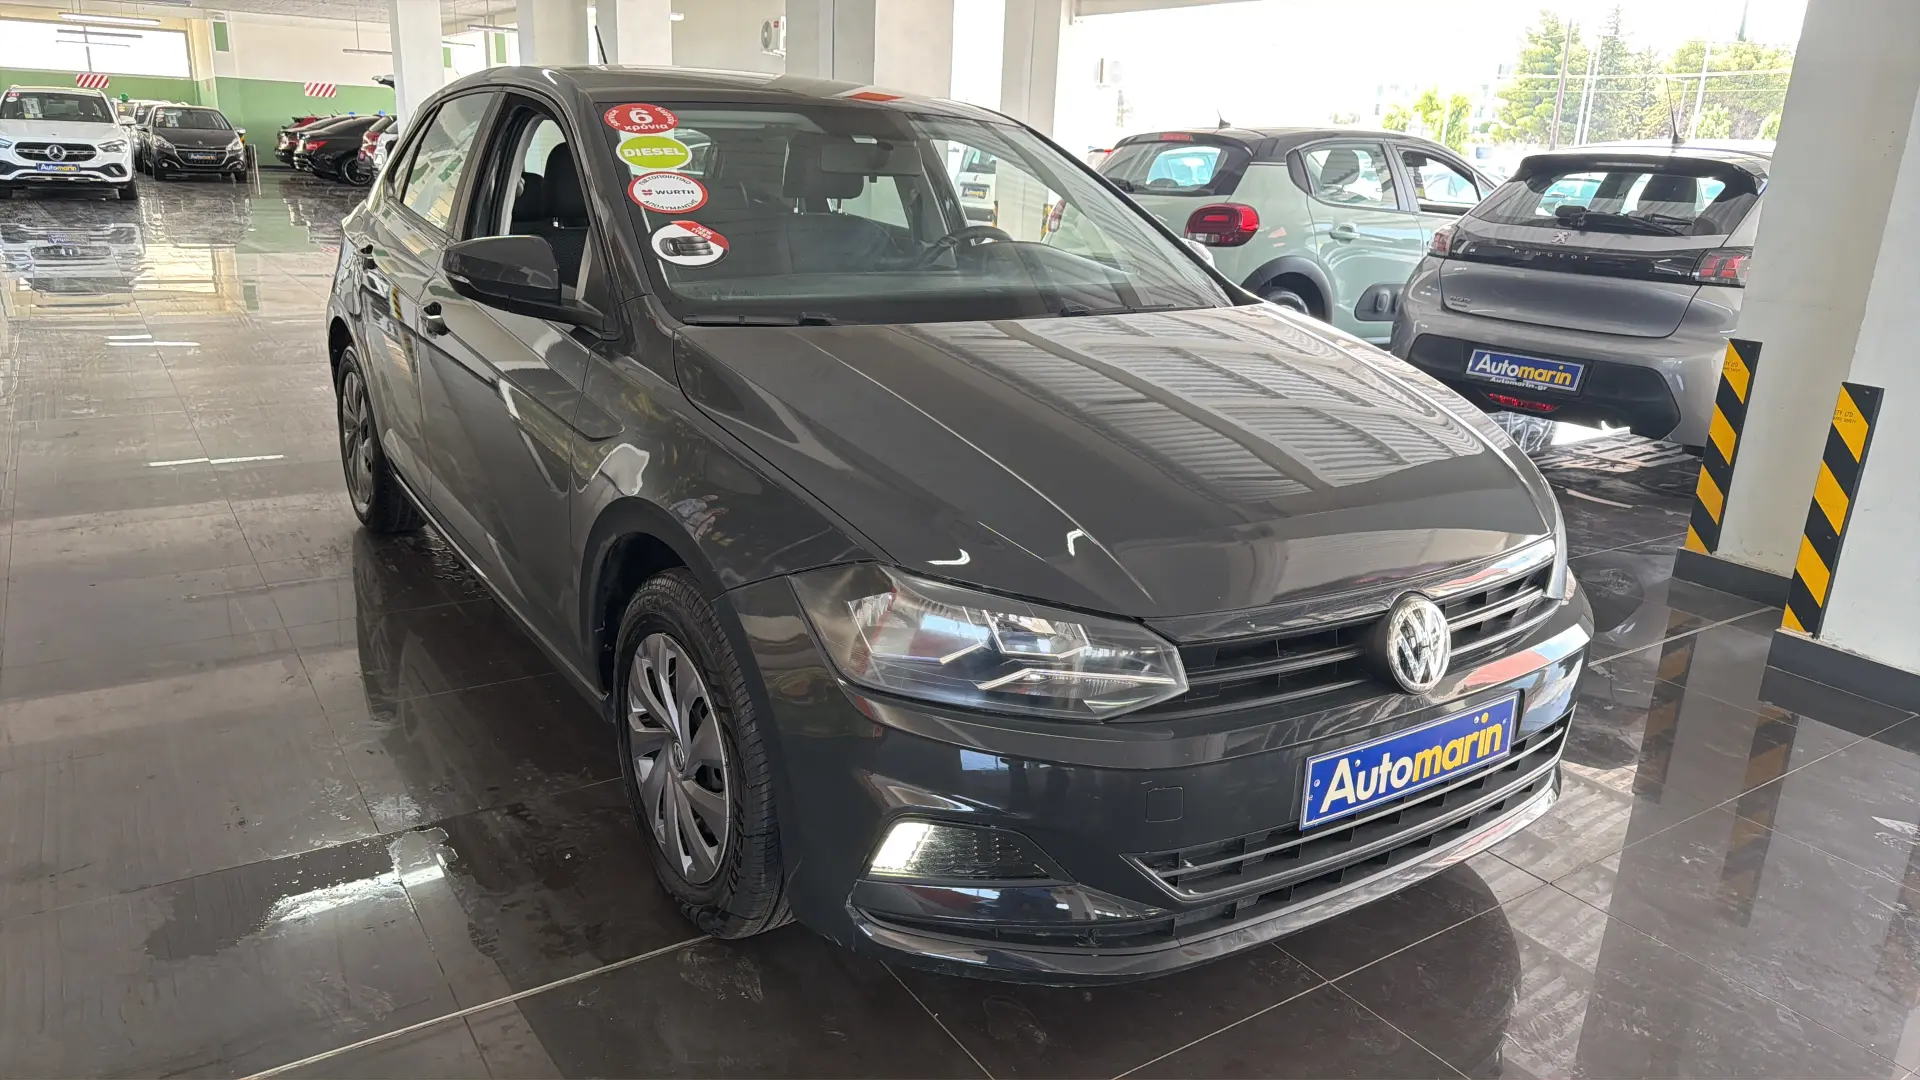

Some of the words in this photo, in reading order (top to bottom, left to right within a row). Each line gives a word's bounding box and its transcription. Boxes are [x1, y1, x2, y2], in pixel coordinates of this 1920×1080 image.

[628, 109, 654, 124] 6
[624, 123, 669, 132] χρόνια
[622, 147, 686, 157] DIESEL
[41, 163, 77, 172] Automarin
[1514, 249, 1590, 261] PEUGEOT
[1474, 353, 1573, 386] Automarin
[1489, 376, 1548, 391] Automarin.gr
[1319, 712, 1503, 814] Automarin
